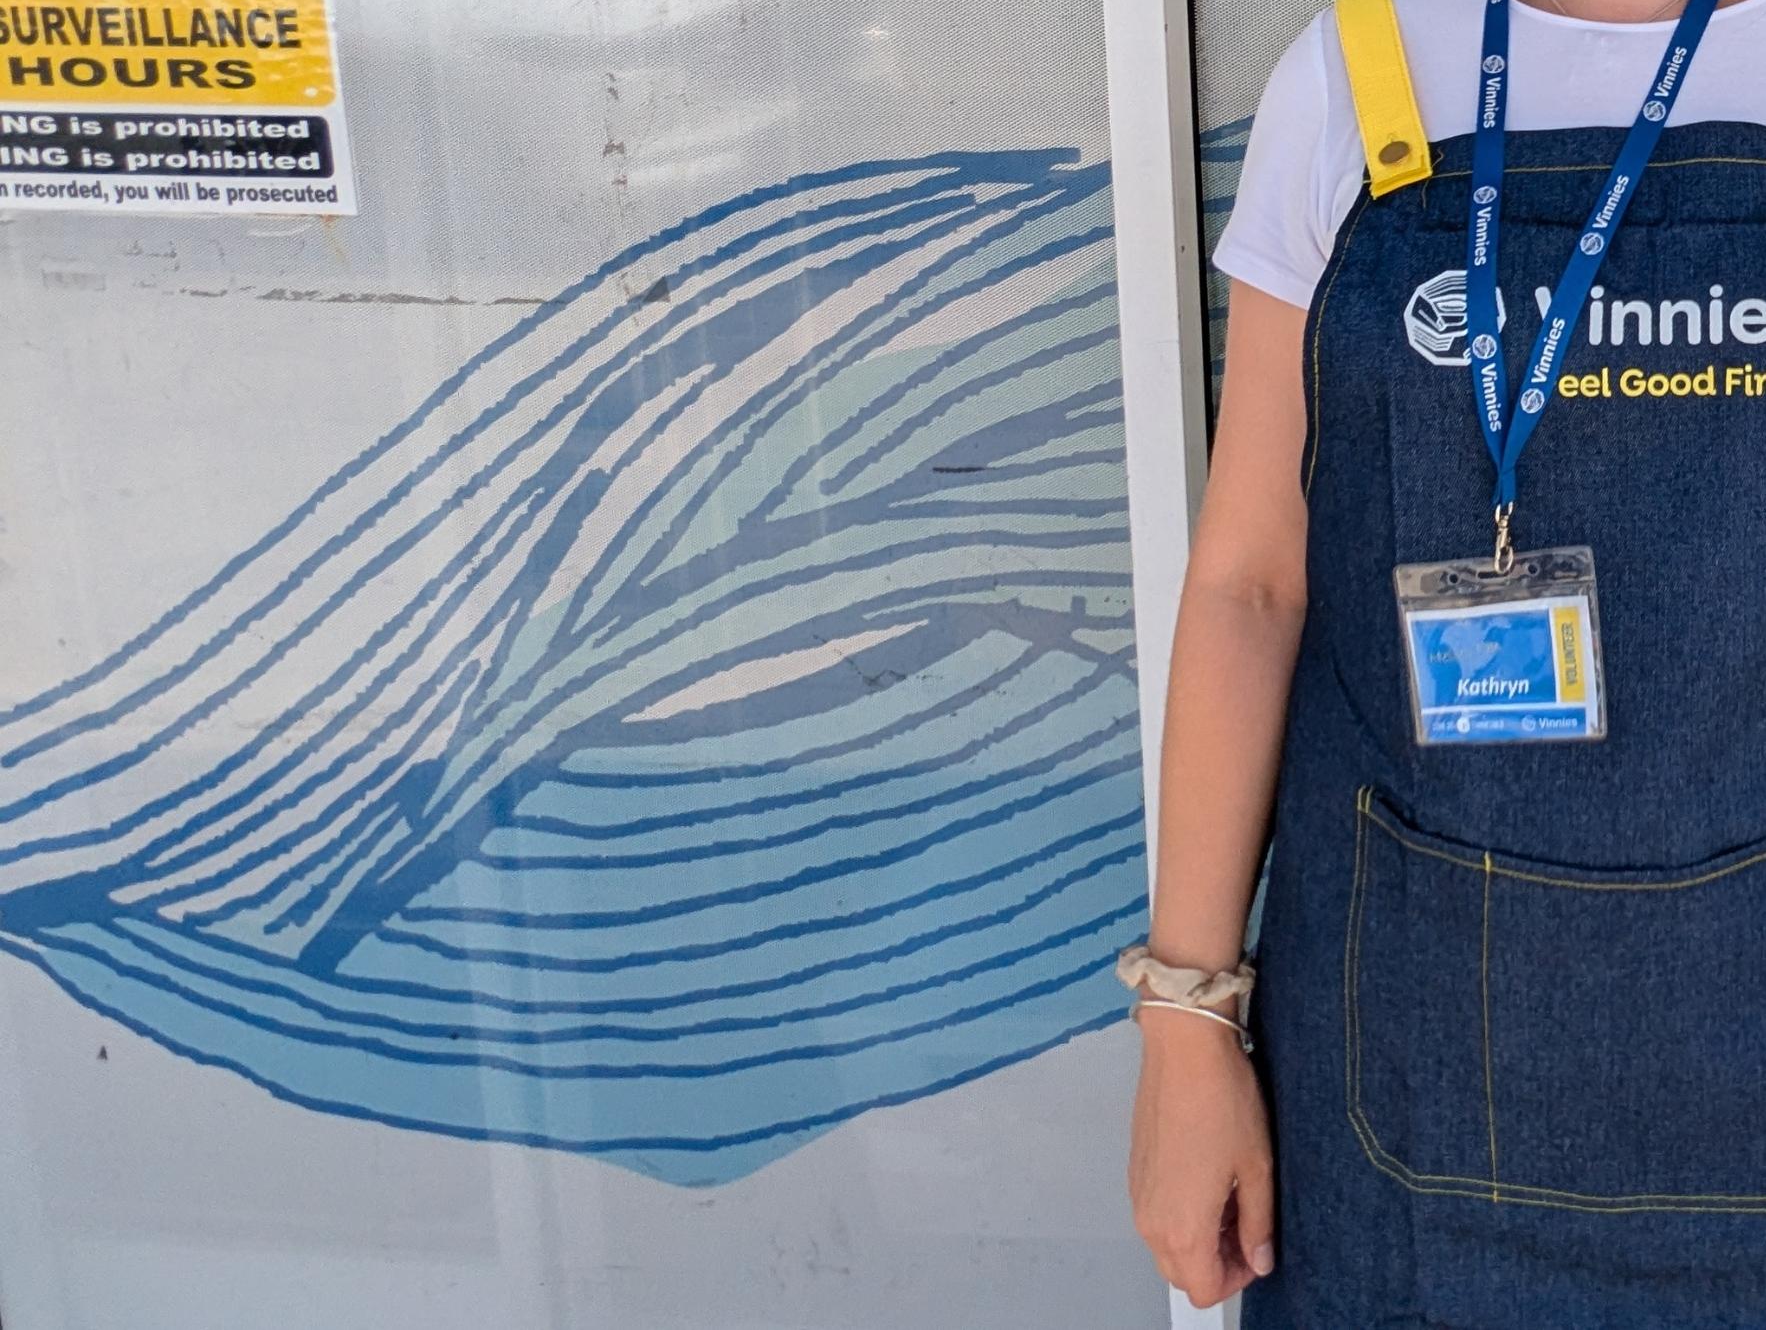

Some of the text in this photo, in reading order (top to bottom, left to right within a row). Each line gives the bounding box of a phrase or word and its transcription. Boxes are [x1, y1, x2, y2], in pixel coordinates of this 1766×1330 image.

[8, 56, 257, 90] HOURS
[1654, 46, 1688, 98] Vinnies
[1483, 77, 1501, 129] Vinnies
[1, 115, 311, 142] NG is prohibited
[81, 148, 114, 168] is
[126, 149, 321, 173] prohibited
[15, 180, 109, 204] recorded,
[114, 184, 151, 204] you
[155, 181, 191, 202] will
[199, 182, 221, 202] be
[227, 184, 339, 205] prosecuted
[1593, 175, 1630, 230] Vinnies
[1474, 207, 1492, 267] Vinnies
[1531, 317, 1565, 383] Vinnies
[1480, 362, 1502, 433] Vinnies
[1558, 366, 1612, 398] eel
[1619, 365, 1715, 398] Good
[1457, 677, 1530, 699] Kathryn
